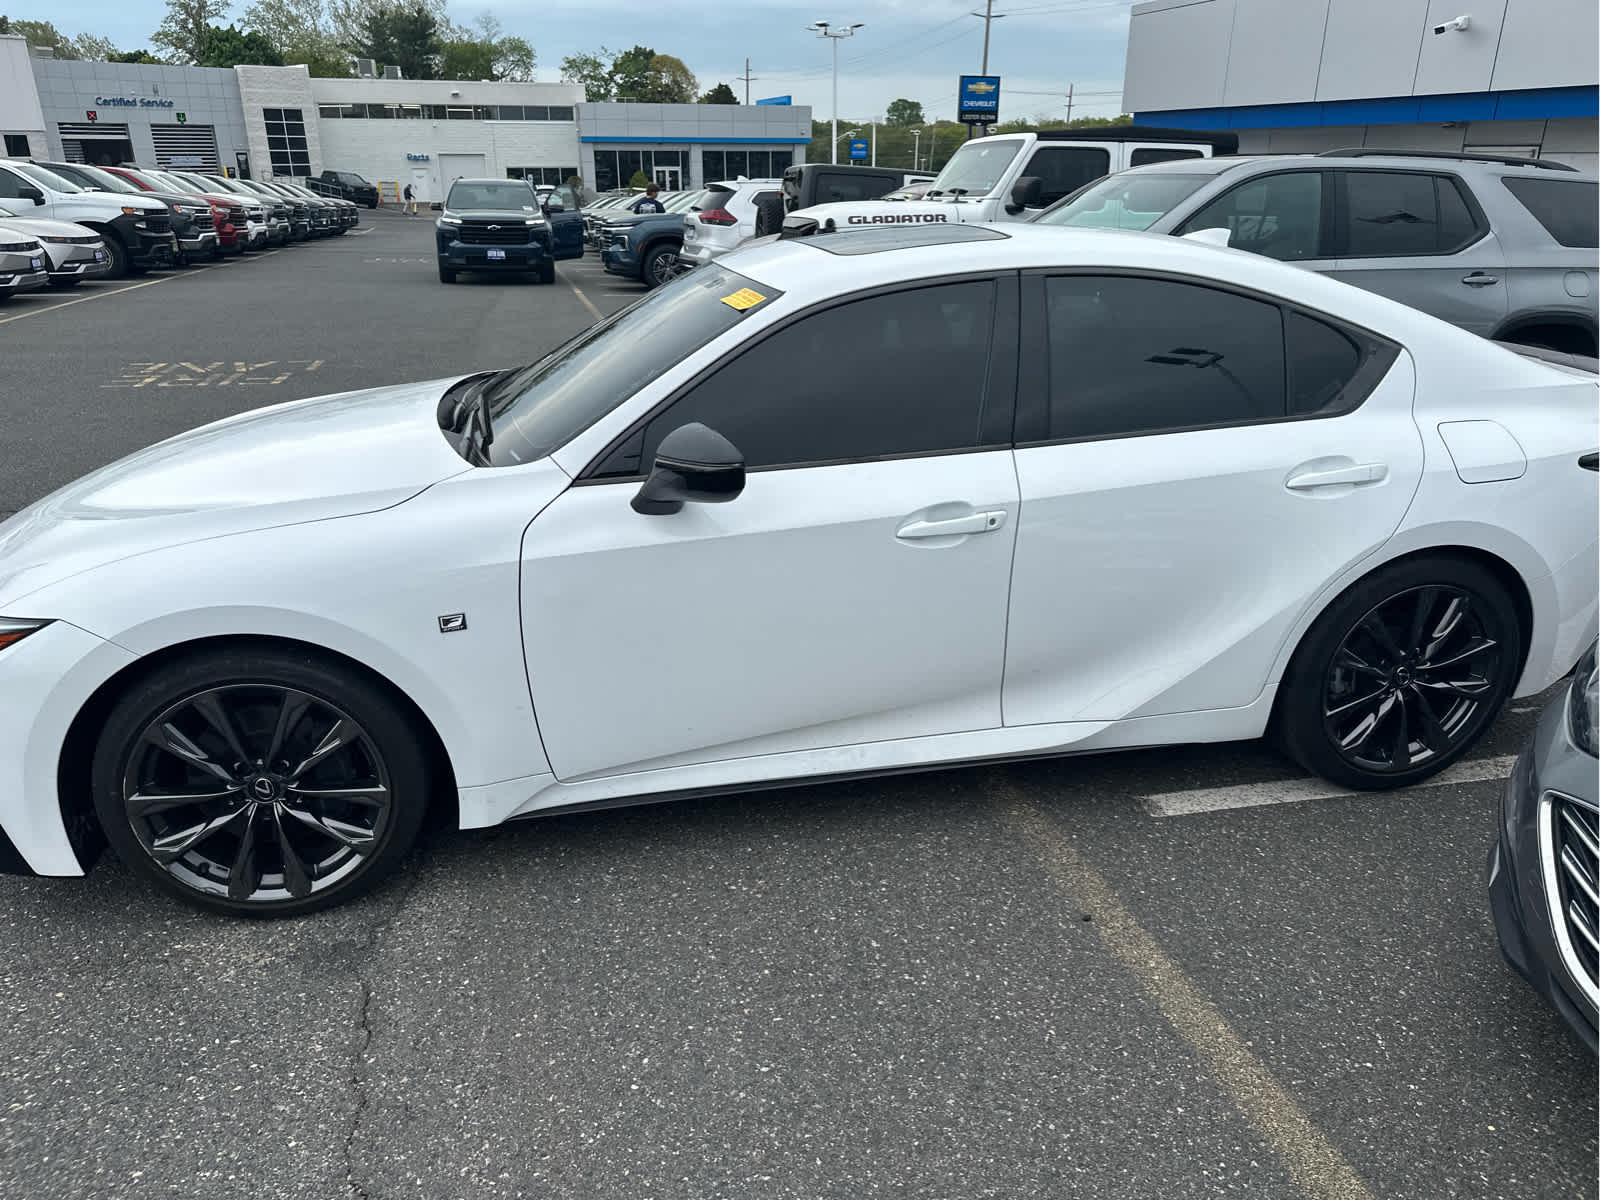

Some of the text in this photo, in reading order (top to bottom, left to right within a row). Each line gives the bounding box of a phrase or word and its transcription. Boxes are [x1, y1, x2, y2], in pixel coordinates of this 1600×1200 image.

[95, 96, 174, 108] Certified Service
[407, 153, 430, 161] Parts
[847, 213, 948, 225] GLADIATOR
